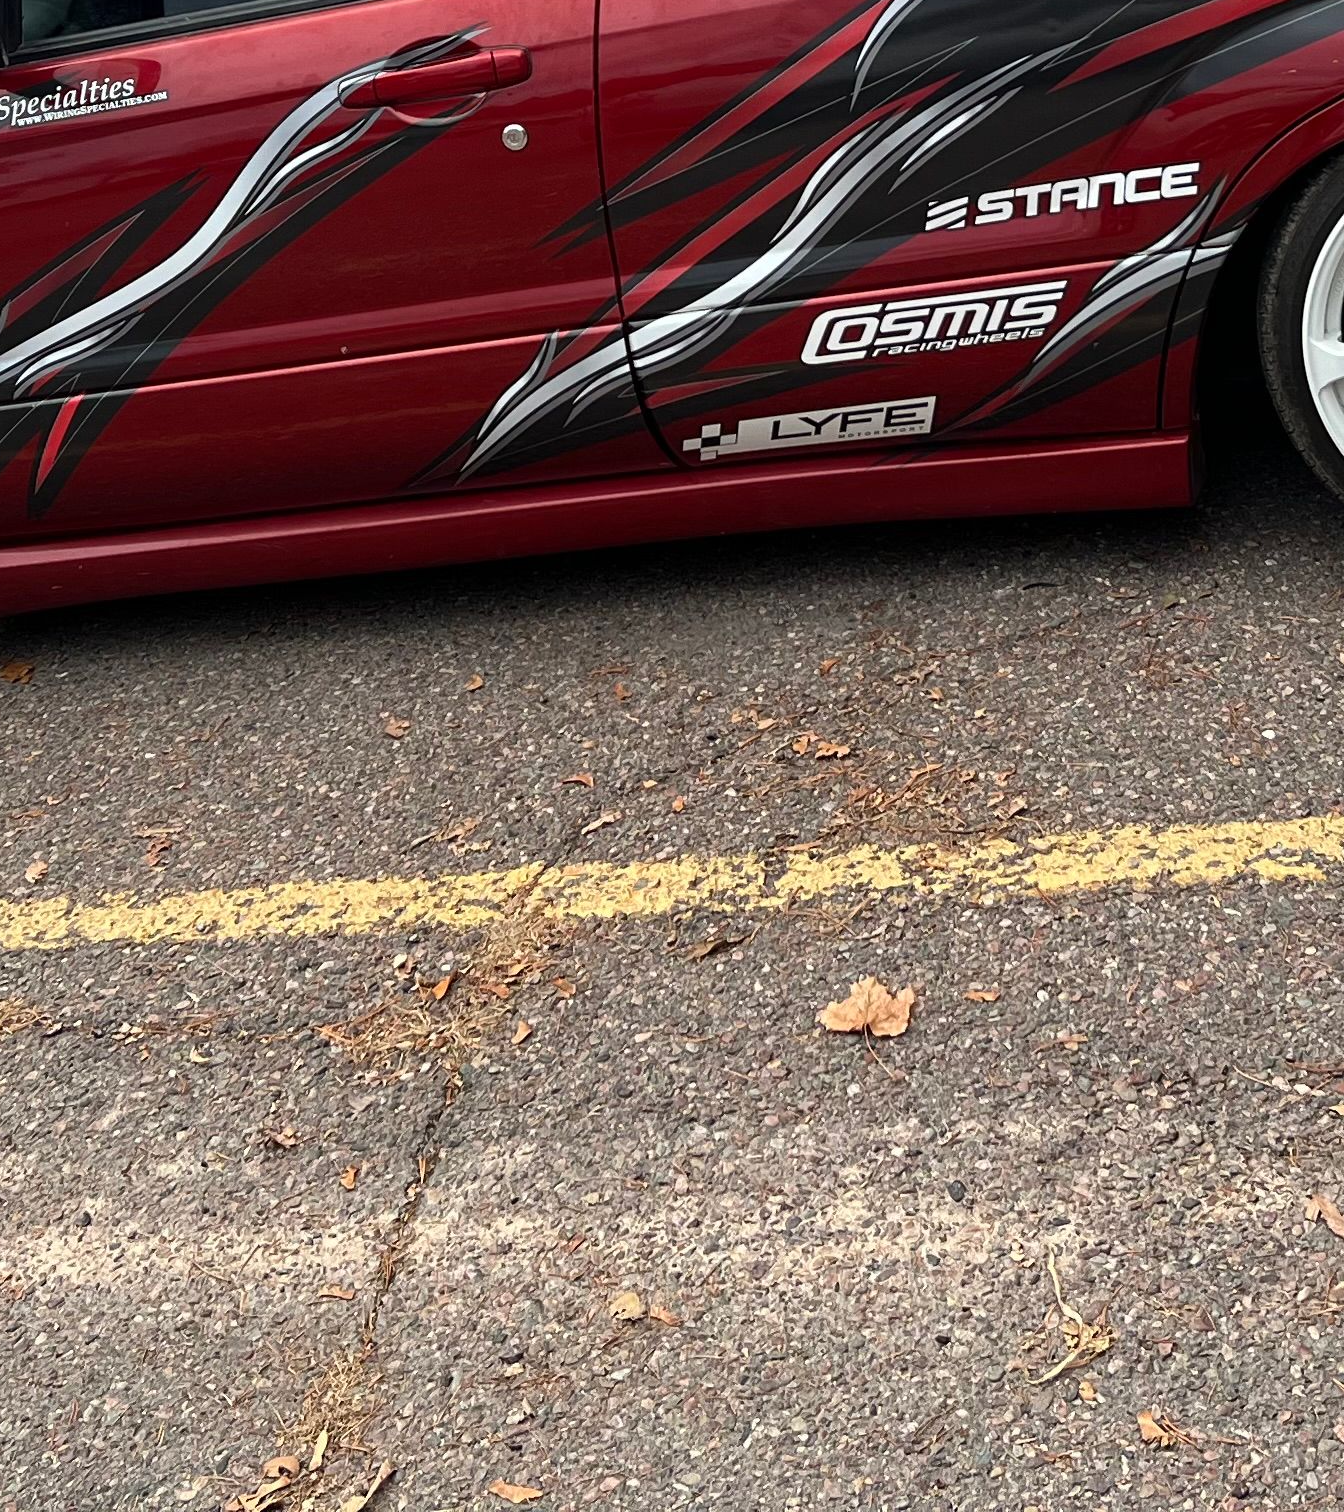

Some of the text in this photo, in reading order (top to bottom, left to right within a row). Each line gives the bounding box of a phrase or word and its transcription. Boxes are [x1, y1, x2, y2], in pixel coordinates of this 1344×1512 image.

[975, 162, 1201, 226] STANCE
[801, 280, 1069, 365] COSMIS
[770, 401, 929, 441] LYFE
[837, 425, 924, 440] MOTORSPORT
